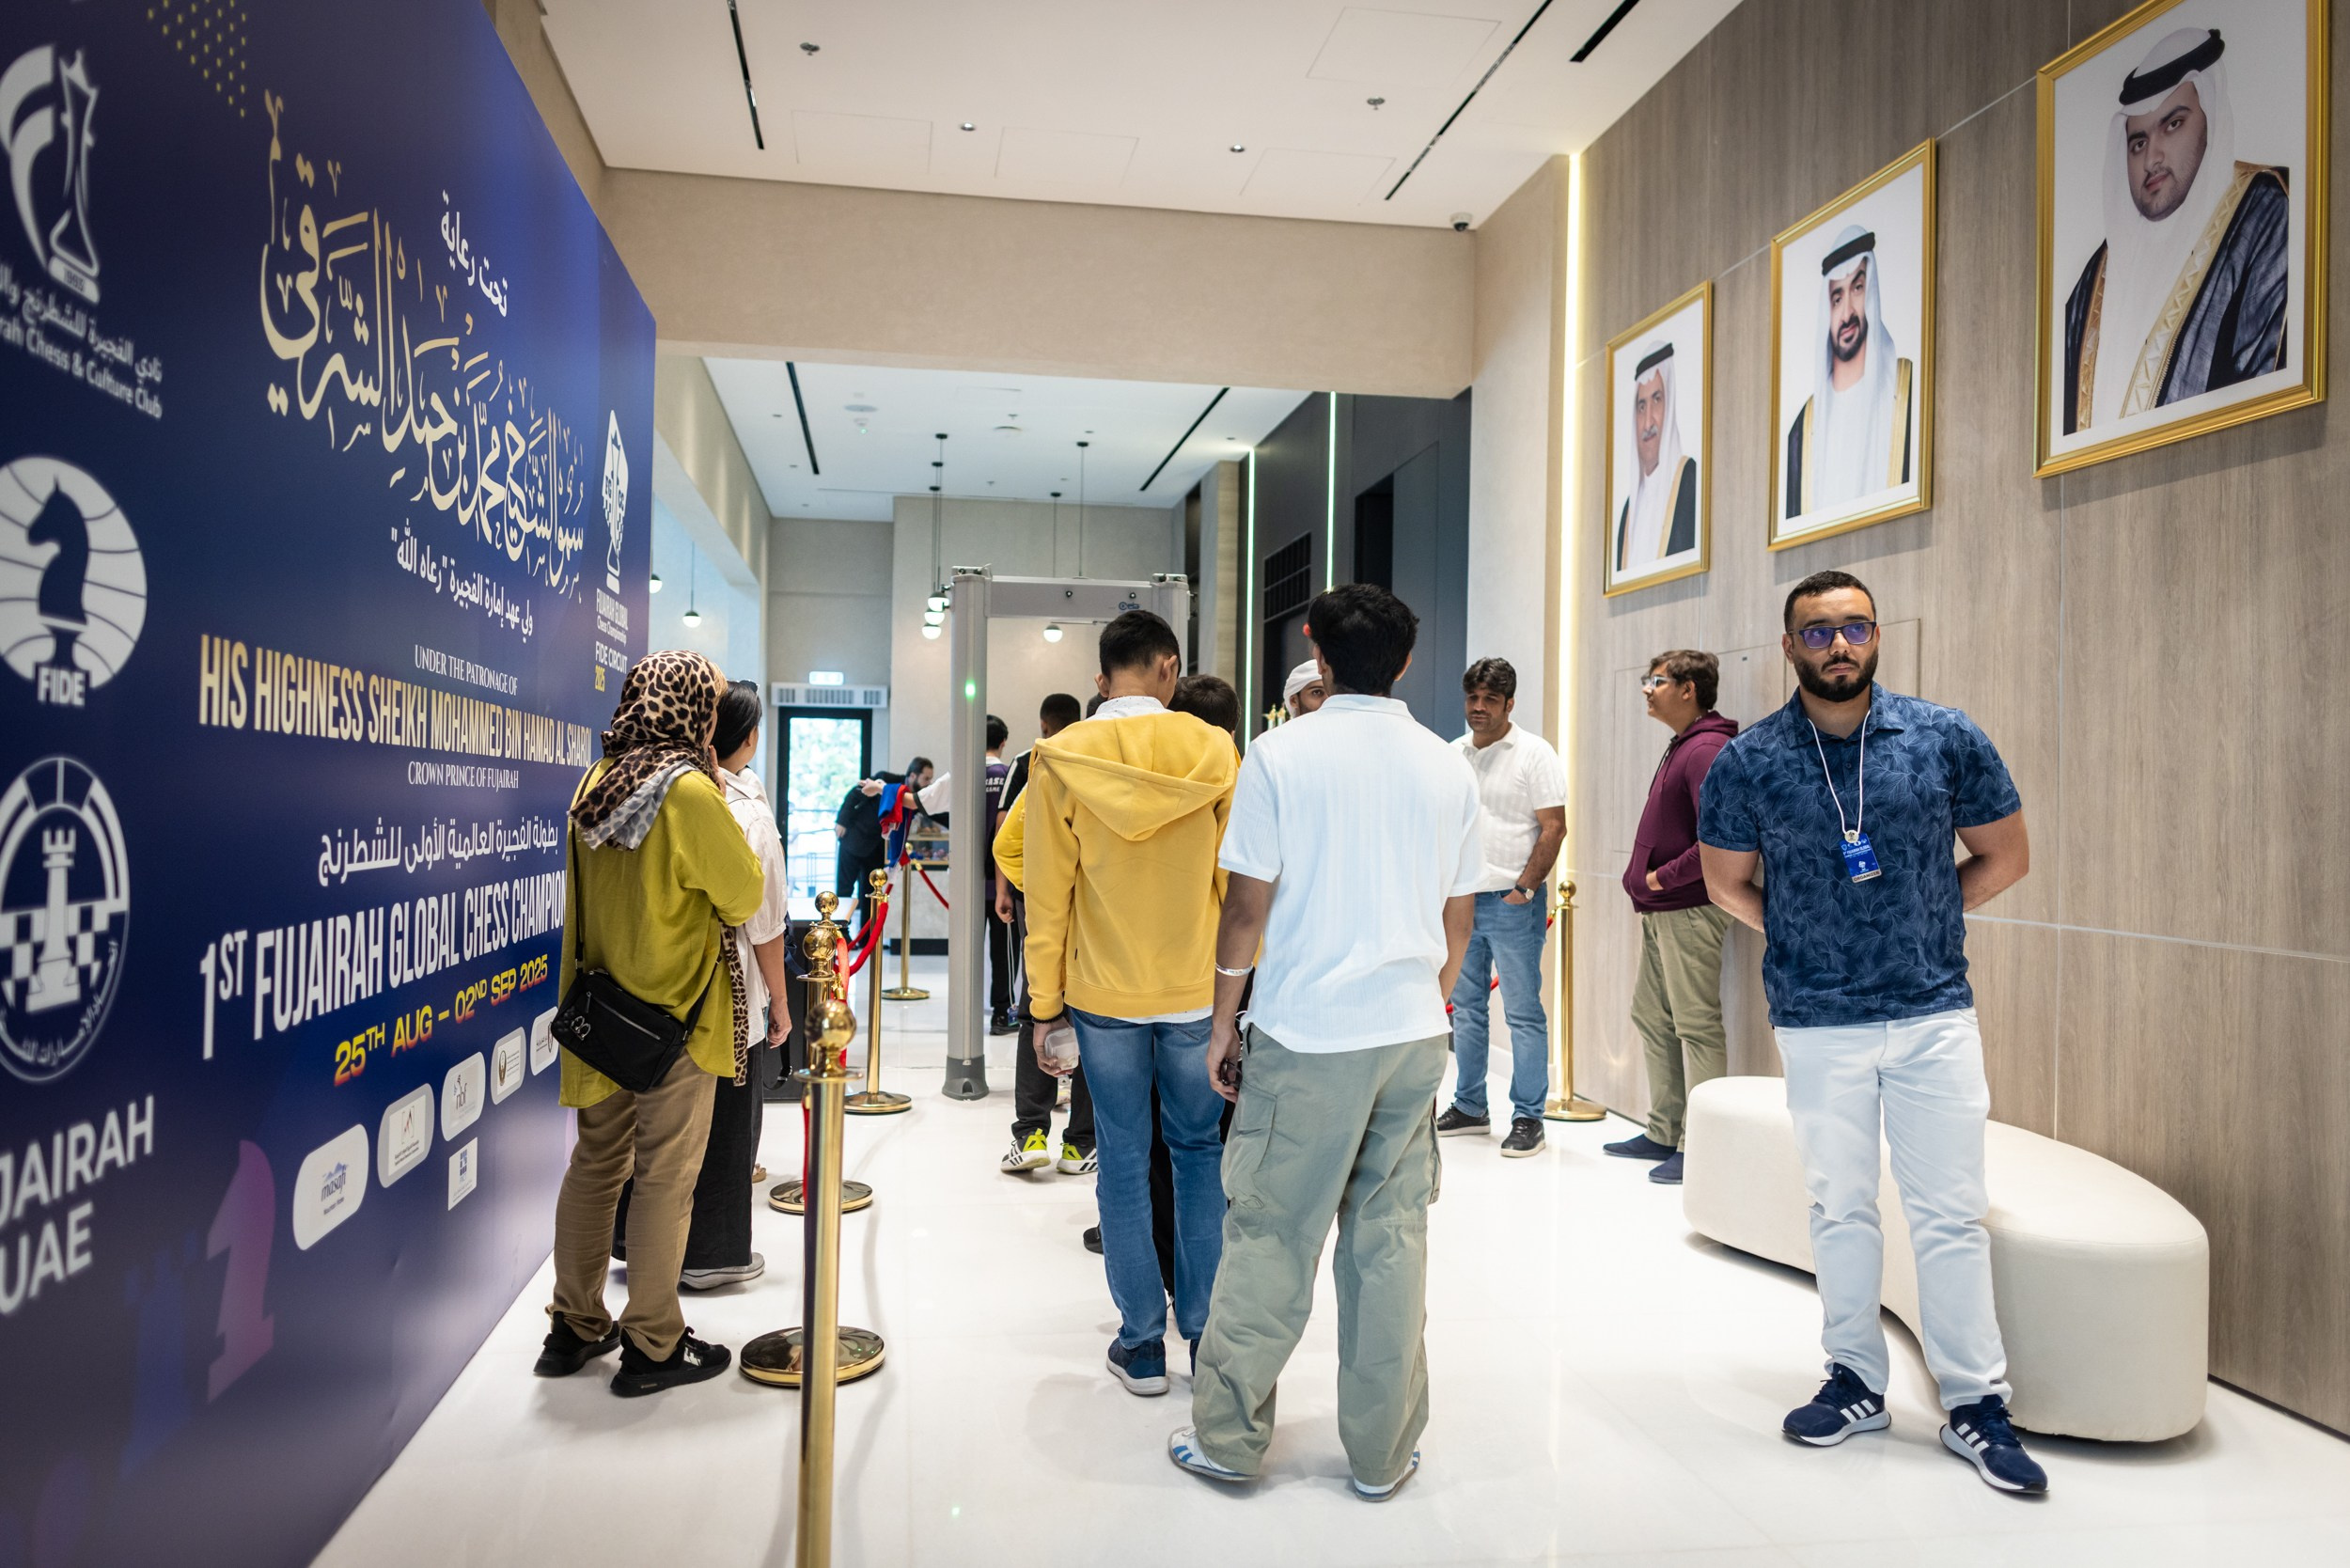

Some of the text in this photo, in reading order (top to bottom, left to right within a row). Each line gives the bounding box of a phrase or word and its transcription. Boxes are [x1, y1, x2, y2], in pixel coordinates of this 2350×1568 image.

[441, 189, 509, 317] تحت رعاية
[26, 326, 70, 371] Chess
[71, 352, 86, 379] &
[86, 359, 133, 405] Culture
[134, 386, 164, 419] Club
[449, 557, 483, 610] الفجيرة
[485, 576, 505, 628] إمارة
[505, 599, 520, 630] عهد
[415, 644, 518, 697] UNDER THE PATRONAGE OF
[595, 664, 605, 693] 2025
[596, 640, 628, 674] FIDE CIRCUIT
[38, 666, 86, 707] FIDE
[199, 634, 592, 770] HIS HIGHNESS SHEIKH MOHAMMED BIN HAMAD AL SHARQI
[408, 760, 520, 793] CROWN PRINCE OF FUJAIRAH
[318, 815, 558, 887] بطولة الفجيرة العالمية الأولى للشطرنج
[1854, 870, 1880, 882] ORGANIZER
[199, 929, 248, 1061] 1ST
[254, 906, 384, 1042] FUJAIRAH
[388, 891, 460, 989] GLOBAL
[463, 880, 509, 962] CHESS
[334, 1022, 385, 1088] 25TH
[390, 1004, 433, 1058] AUG
[455, 979, 487, 1024] 02ND
[491, 967, 516, 1007] SEP
[519, 953, 548, 993] 2025
[321, 1171, 347, 1202] masafi
[0, 1201, 93, 1314] UAE
